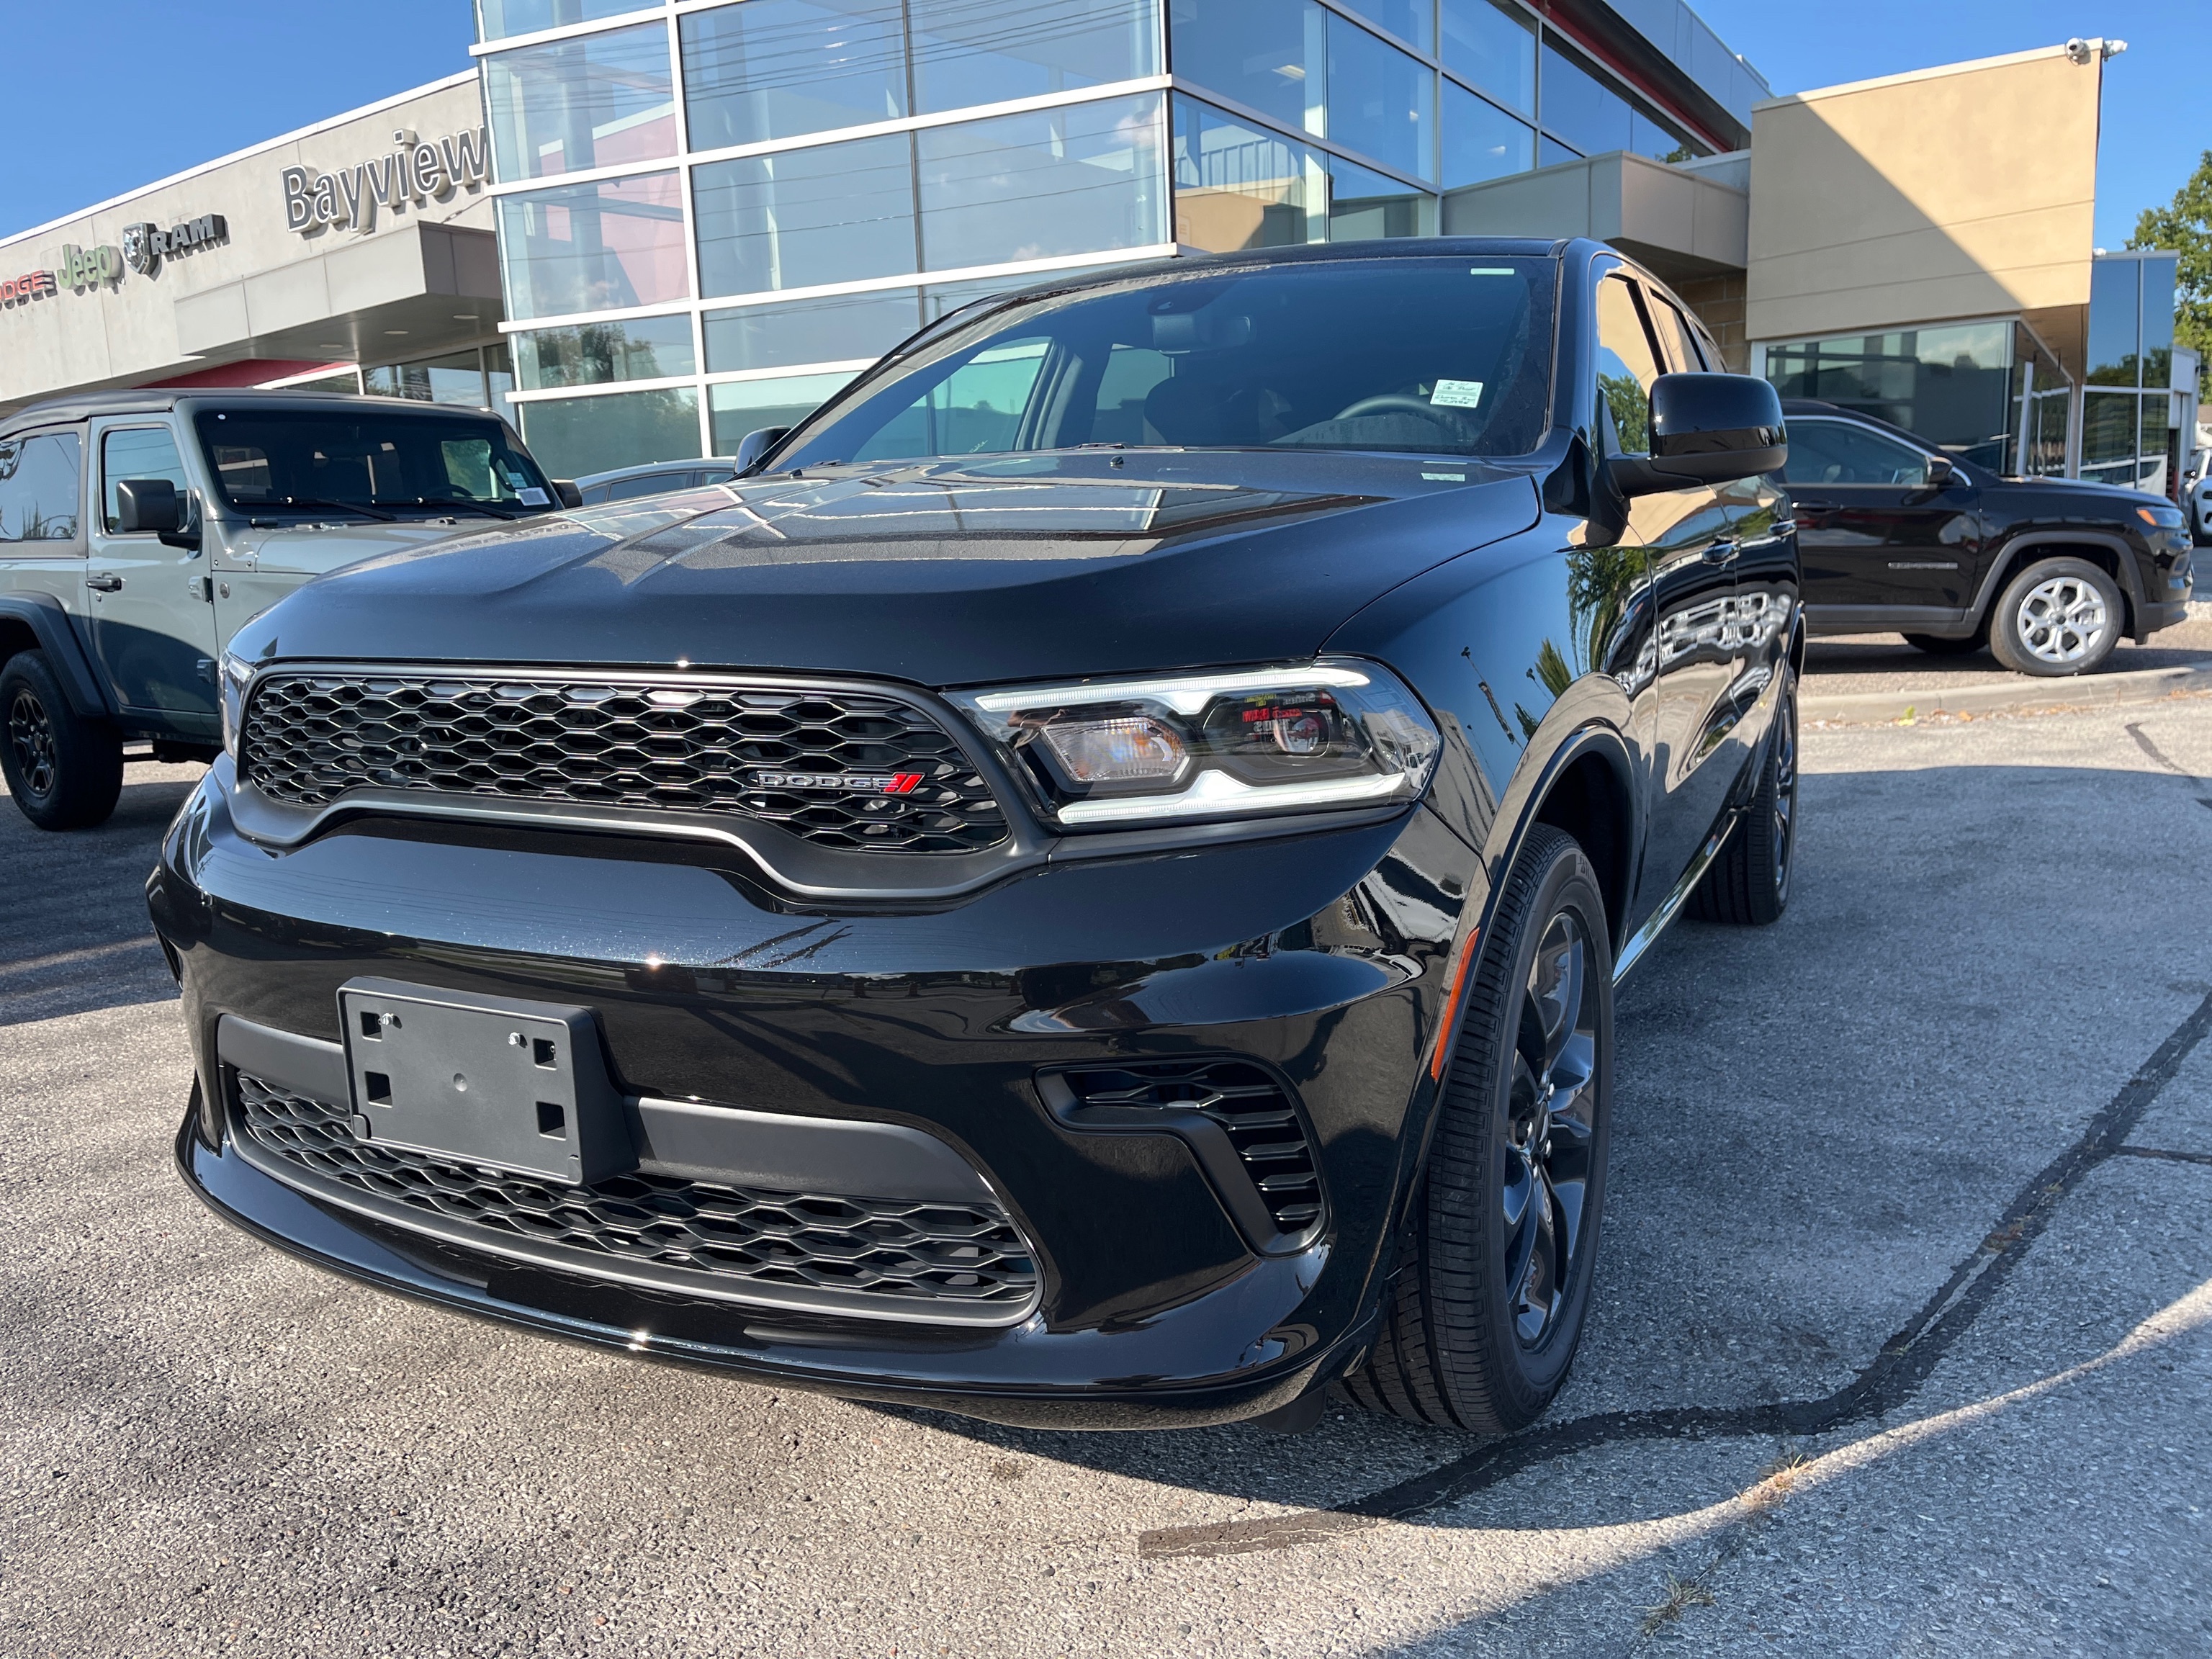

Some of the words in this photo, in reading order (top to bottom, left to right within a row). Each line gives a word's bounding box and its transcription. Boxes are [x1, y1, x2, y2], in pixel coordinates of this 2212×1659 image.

[280, 125, 488, 233] Bayview
[149, 214, 215, 256] RAM
[0, 270, 45, 300] DGE
[57, 243, 113, 290] Jeep
[758, 773, 899, 789] DODGE
